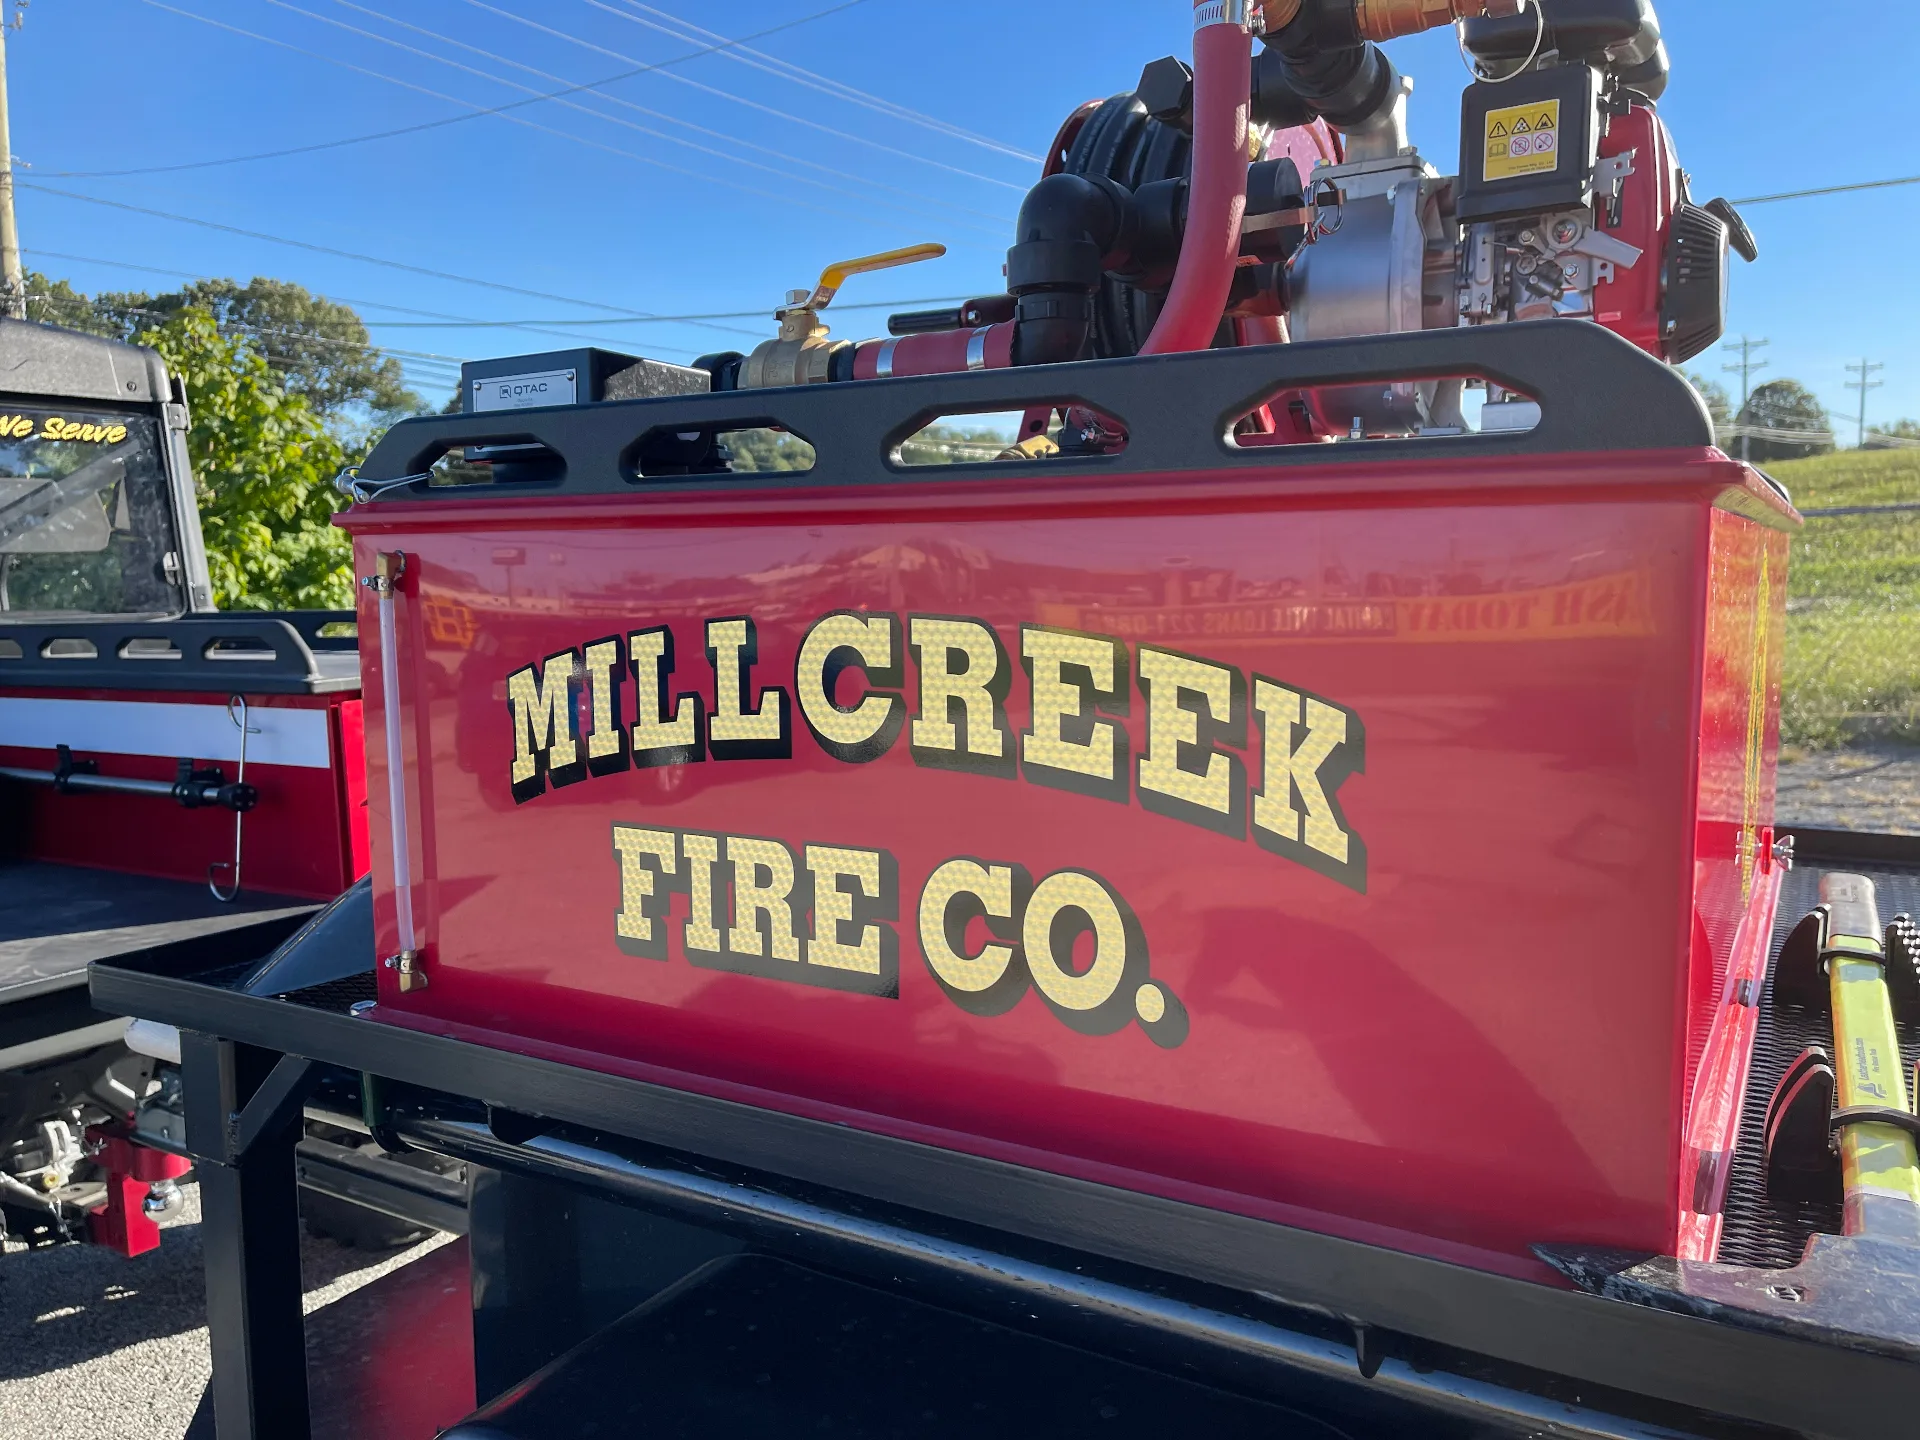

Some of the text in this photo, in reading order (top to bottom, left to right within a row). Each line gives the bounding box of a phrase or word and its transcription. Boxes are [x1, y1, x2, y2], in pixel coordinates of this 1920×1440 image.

[40, 417, 127, 444] Serve
[514, 383, 547, 396] QTAC
[506, 609, 1366, 894] MILL CREEK
[611, 822, 1190, 1048] FIRE CO.
